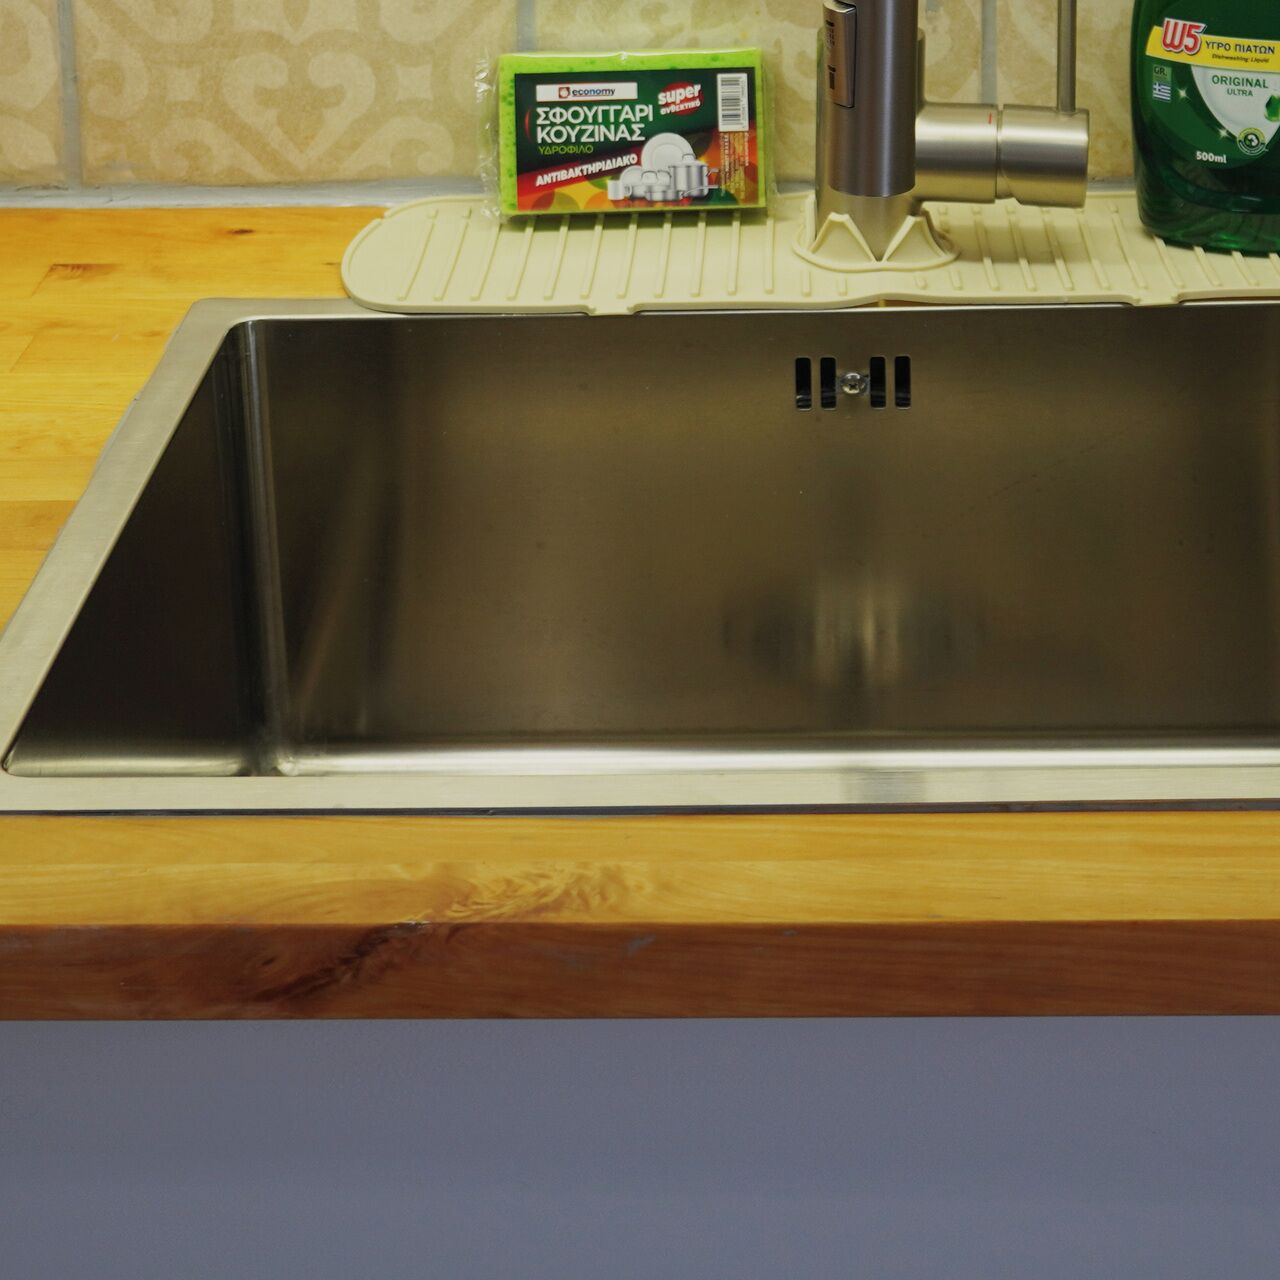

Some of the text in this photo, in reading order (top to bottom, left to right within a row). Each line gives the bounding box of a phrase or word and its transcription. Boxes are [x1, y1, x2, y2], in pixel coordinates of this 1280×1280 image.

[1162, 19, 1205, 54] W5
[1205, 41, 1276, 55] ΥΓΡΟ ΠΙΑΤΩΝ
[1212, 54, 1249, 63] Dishwashing
[1211, 74, 1269, 89] ORIGINAL
[572, 86, 616, 99] economy
[658, 83, 702, 106] super
[1226, 88, 1254, 97] ULTRA
[535, 104, 654, 125] ΣΦΟΥΓΓΑΡΙ
[535, 123, 647, 144] ΚΟΥΖΙΝΑΣ
[538, 144, 594, 155] ΥΔΡΟΦΙΛΟ
[1196, 151, 1227, 163] 500ml
[535, 153, 639, 187] ΑΝΤΙΒΑΚΤΗΡΙΔΙΑΚΟ
